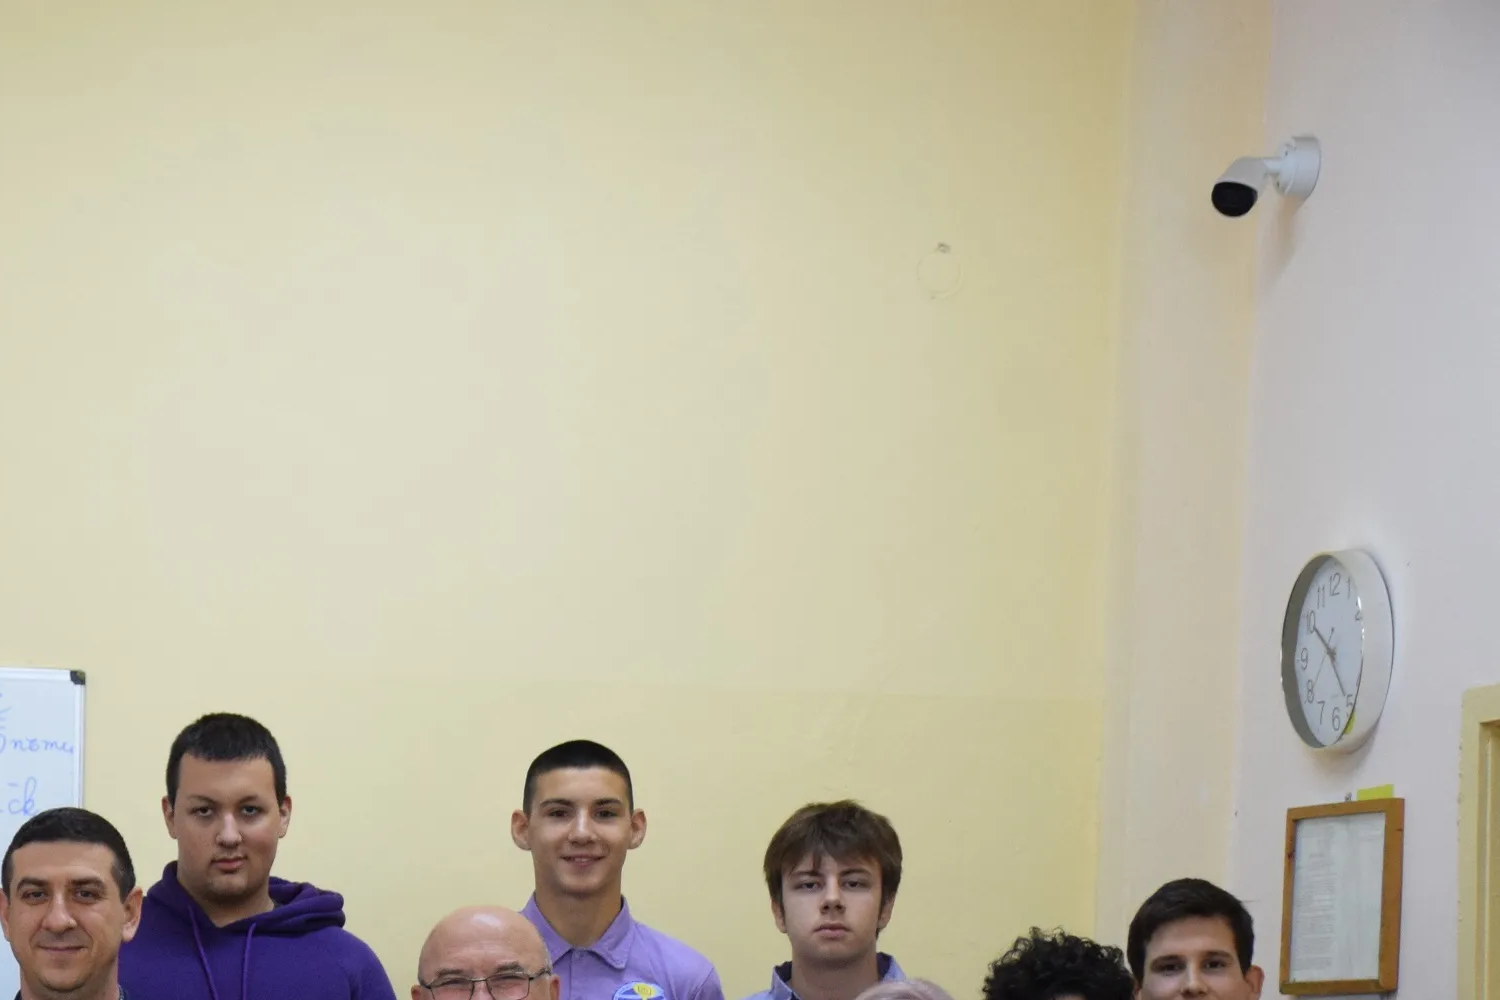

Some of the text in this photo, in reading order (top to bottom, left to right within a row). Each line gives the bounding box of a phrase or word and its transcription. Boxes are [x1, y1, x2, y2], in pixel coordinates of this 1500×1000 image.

[1316, 585, 1326, 609] 11
[1329, 572, 1341, 597] 12
[1306, 610, 1316, 634] 10
[1300, 647, 1309, 671] 9
[1306, 679, 1315, 704] 8
[1317, 700, 1325, 725] 7
[1331, 706, 1341, 732] 6
